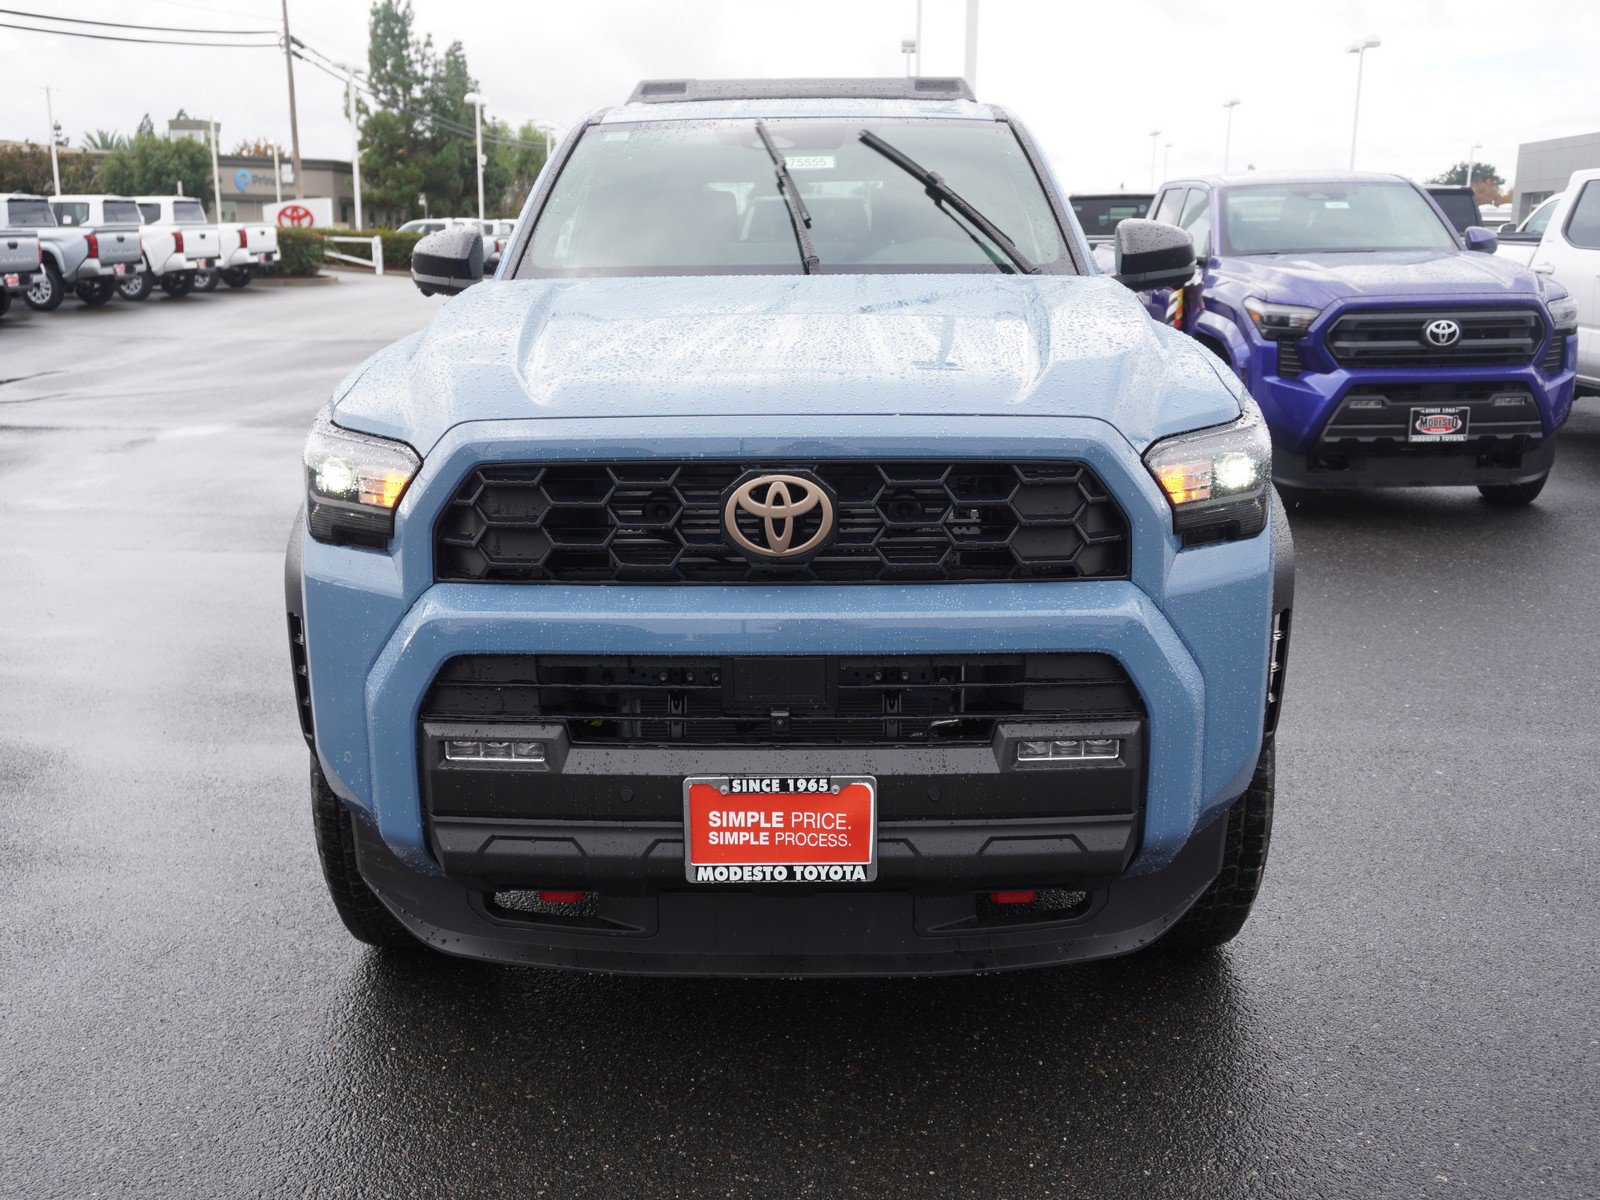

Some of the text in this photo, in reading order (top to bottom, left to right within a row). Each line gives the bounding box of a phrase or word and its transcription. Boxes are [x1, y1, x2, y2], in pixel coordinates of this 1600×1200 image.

[731, 778, 829, 793] SINCE 1965
[708, 811, 852, 830] SIMPLE PRICE.
[708, 831, 852, 847] SIMPLE PROCESS.
[697, 865, 866, 882] MODESTO TOYOTA
